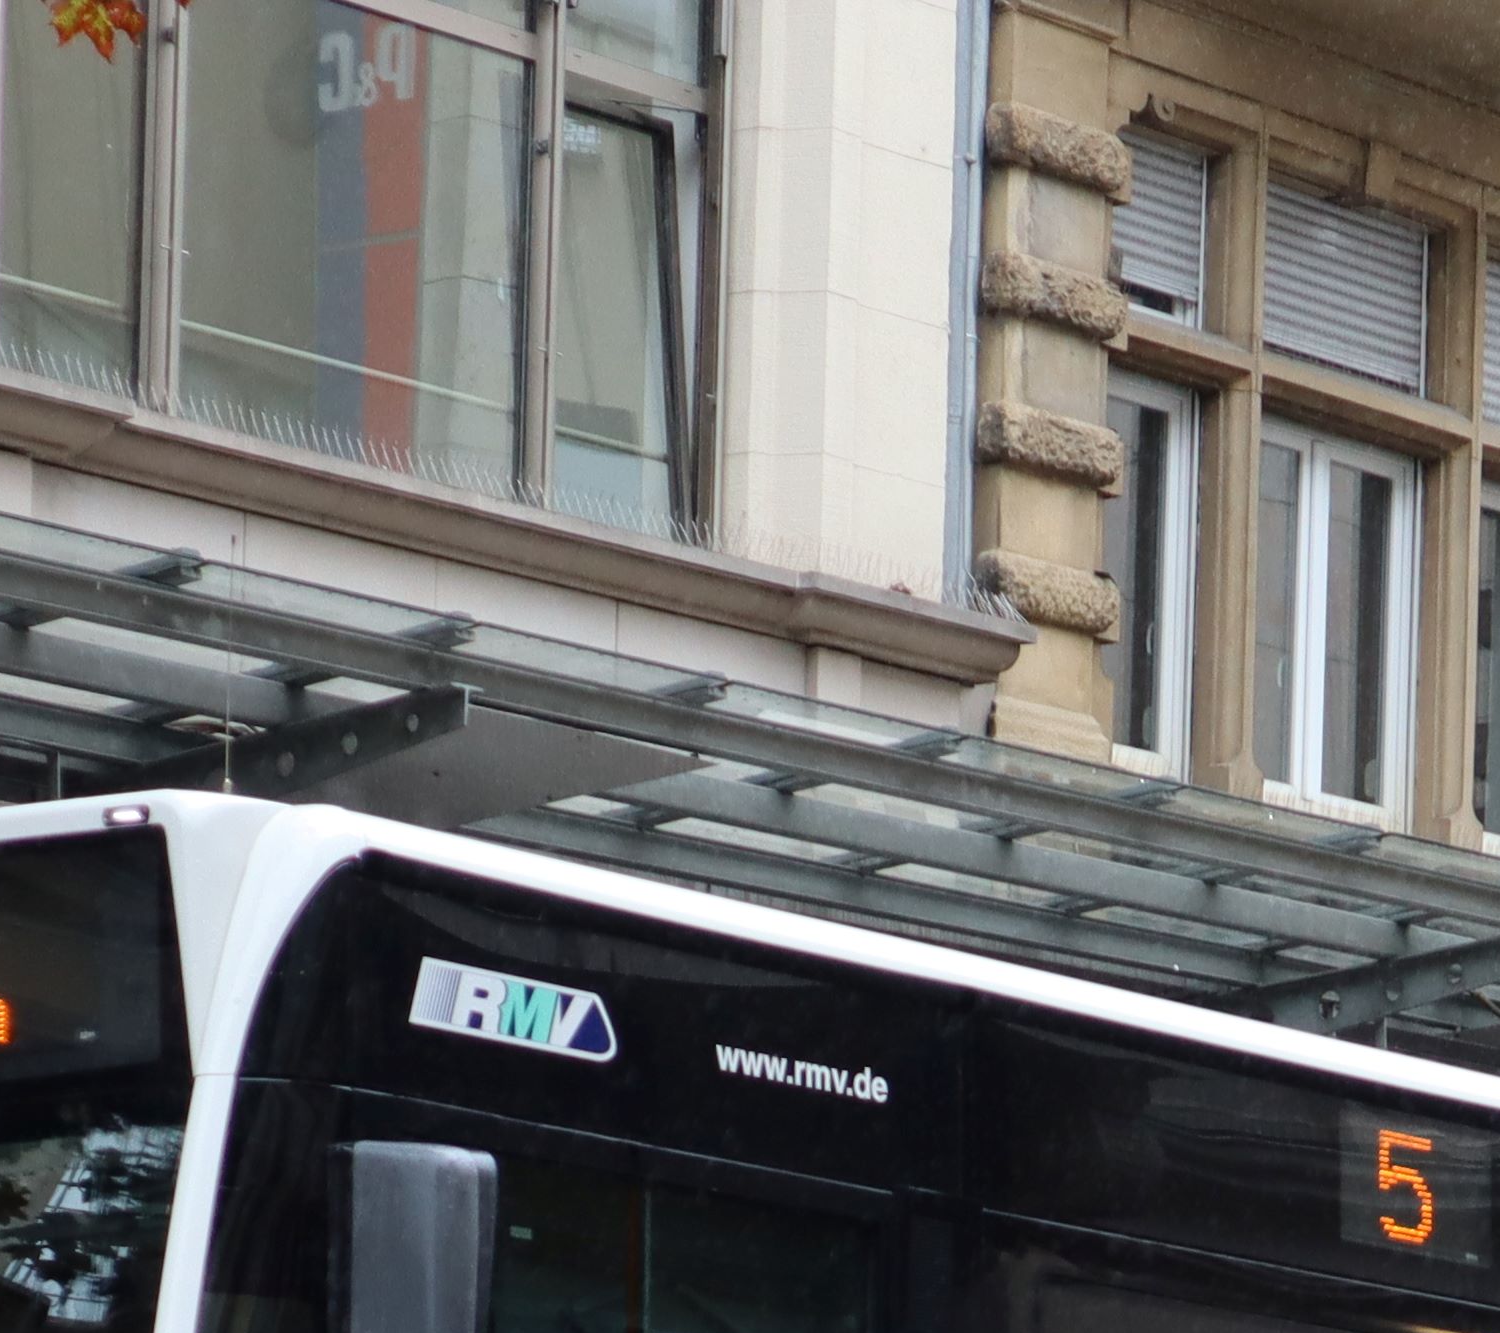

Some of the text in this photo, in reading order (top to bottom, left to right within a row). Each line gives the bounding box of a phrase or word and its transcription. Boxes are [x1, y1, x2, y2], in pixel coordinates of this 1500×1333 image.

[435, 964, 602, 1053] RMV
[715, 1043, 890, 1104] www.rmv.de
[1378, 1128, 1434, 1245] 5
